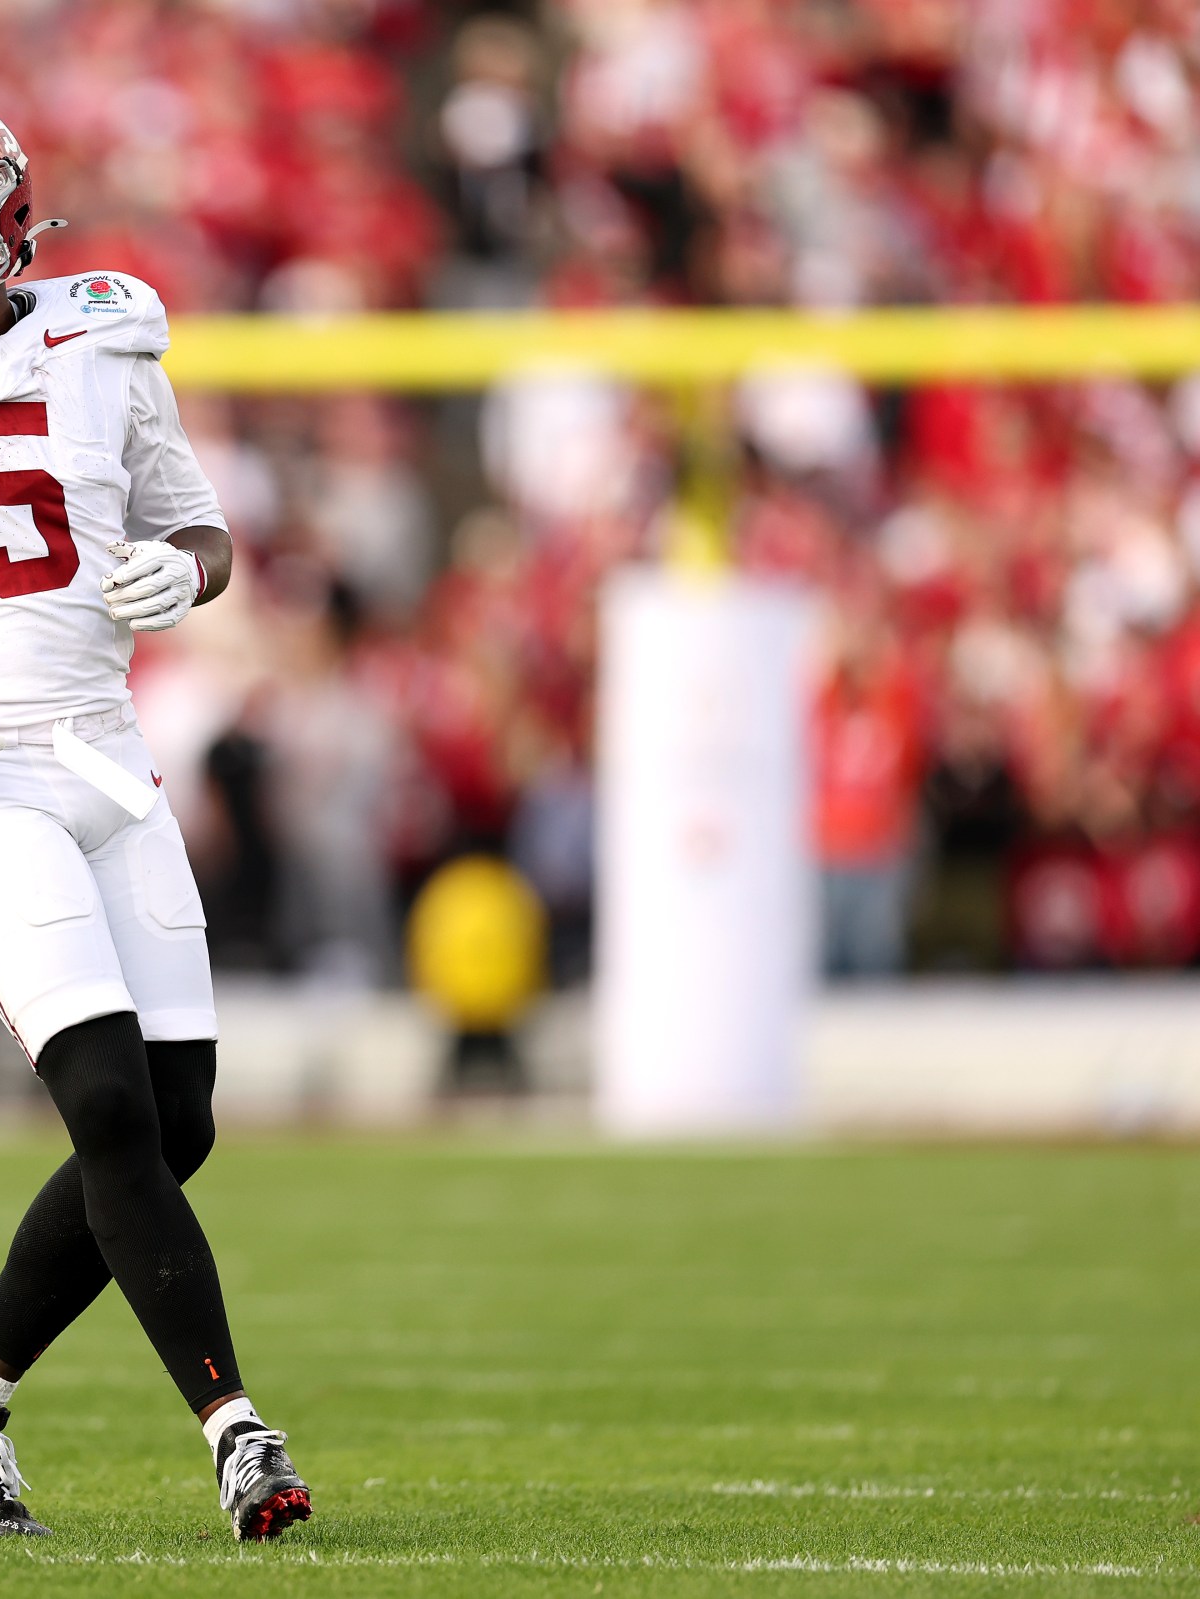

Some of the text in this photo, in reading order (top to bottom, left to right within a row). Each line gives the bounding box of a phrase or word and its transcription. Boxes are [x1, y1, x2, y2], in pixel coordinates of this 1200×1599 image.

[81, 275, 112, 284] BOWL
[113, 278, 133, 300] GAME
[92, 306, 128, 314] Prudential
